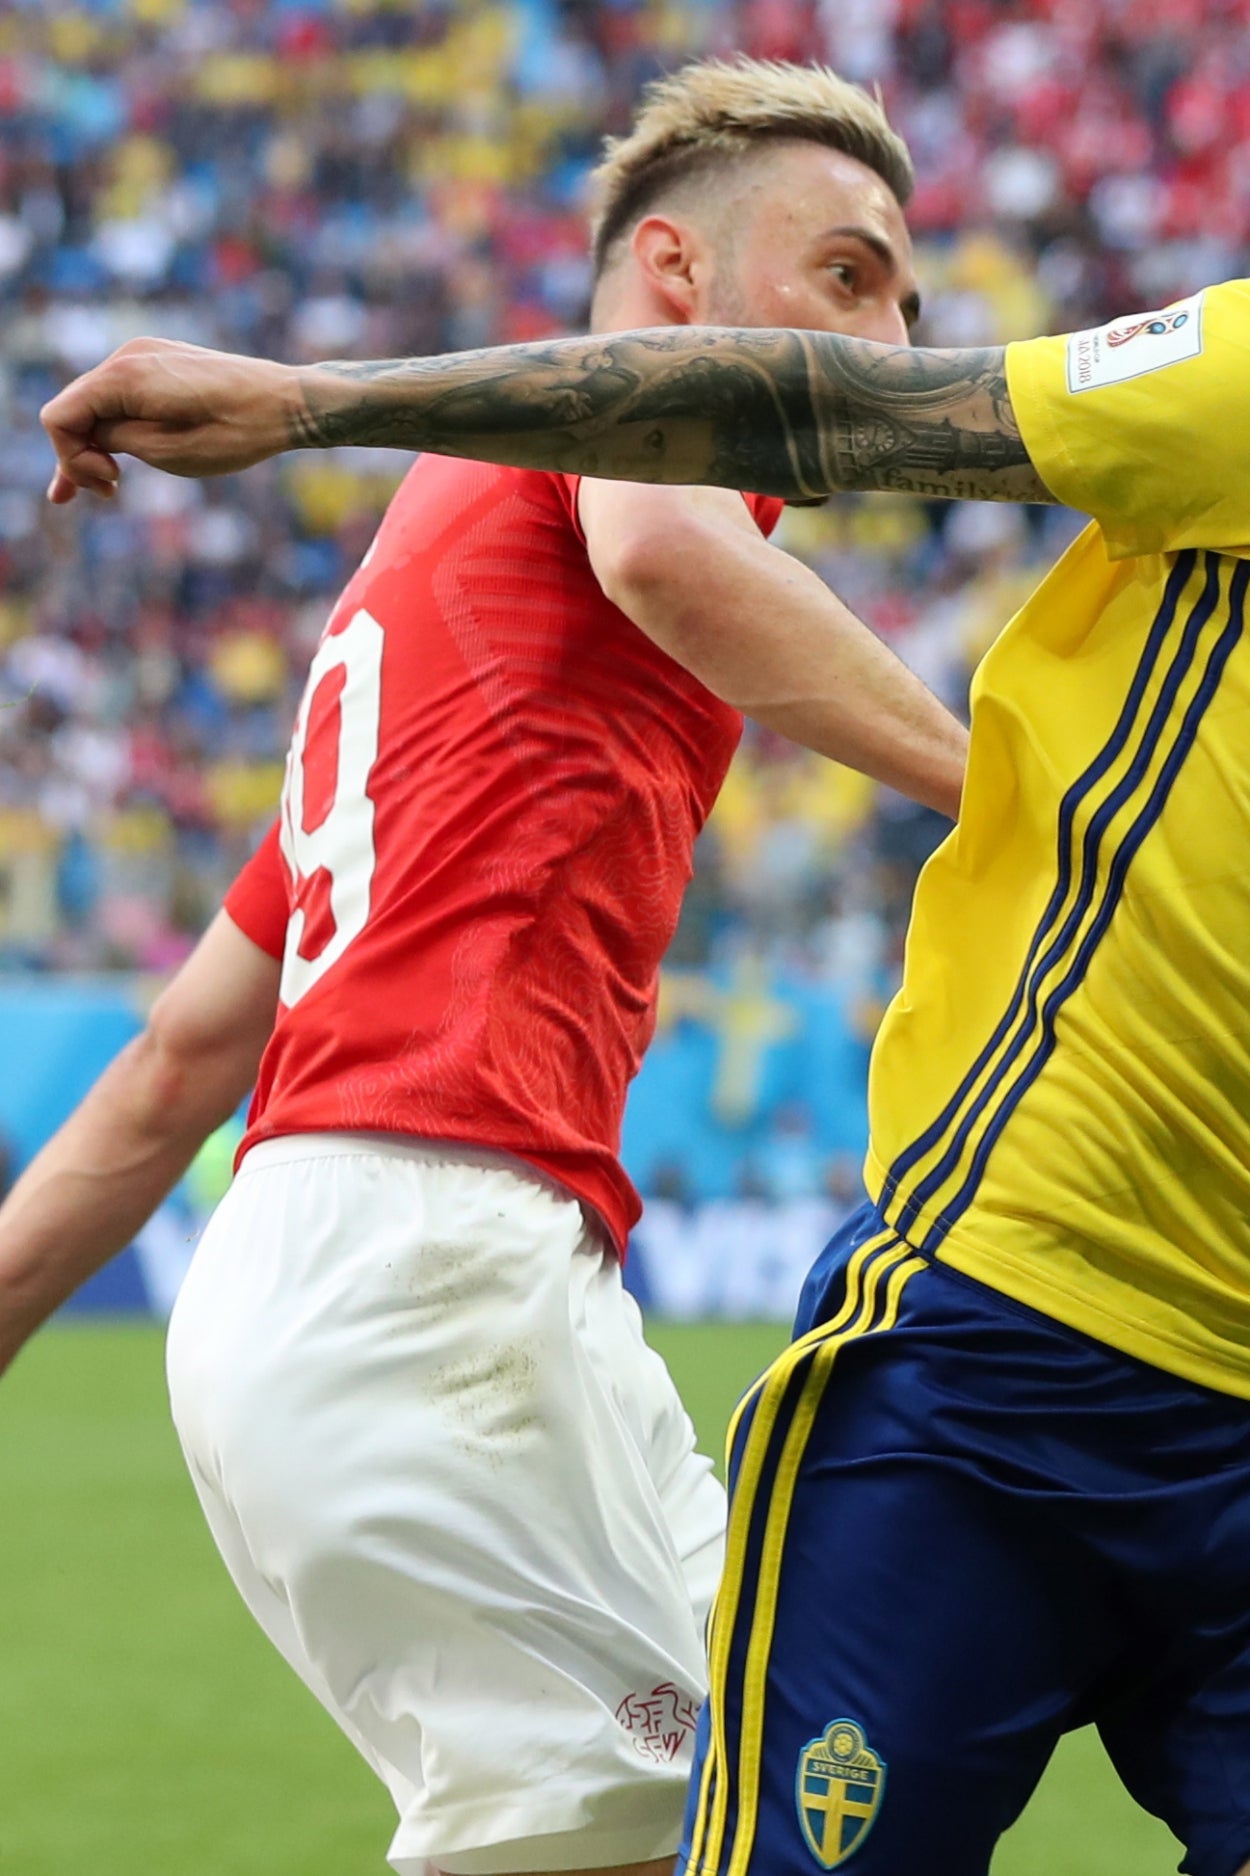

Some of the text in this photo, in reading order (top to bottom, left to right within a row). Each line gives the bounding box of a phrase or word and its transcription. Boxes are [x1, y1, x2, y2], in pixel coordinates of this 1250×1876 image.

[1079, 355, 1091, 383] 2018
[882, 467, 998, 500] family
[813, 1762, 869, 1780] SVERIGE
